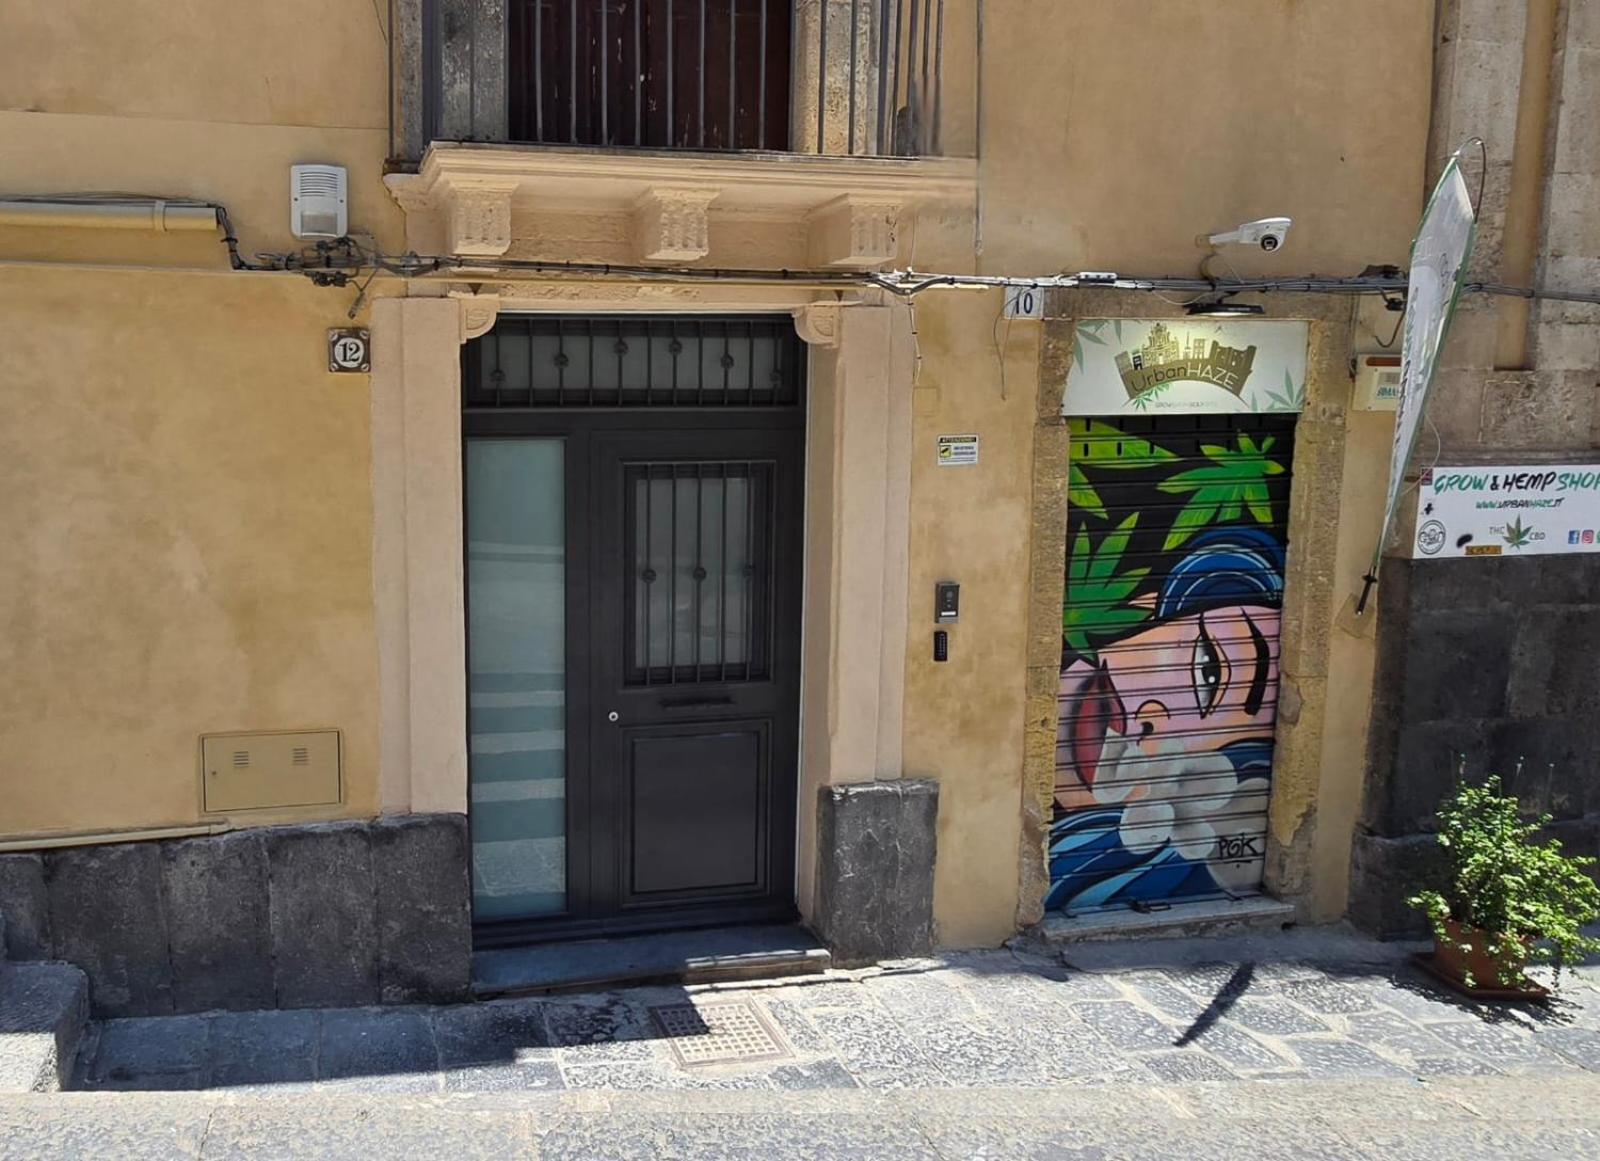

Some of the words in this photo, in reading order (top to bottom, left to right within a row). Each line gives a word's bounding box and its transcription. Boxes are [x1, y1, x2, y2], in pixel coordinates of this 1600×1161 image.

[1015, 292, 1034, 315] 10
[339, 341, 361, 362] 12
[1433, 473, 1490, 495] GROW
[1490, 475, 1500, 491] &
[1502, 471, 1557, 493] HEMP
[1489, 526, 1505, 535] THC
[1529, 532, 1546, 541] CBD
